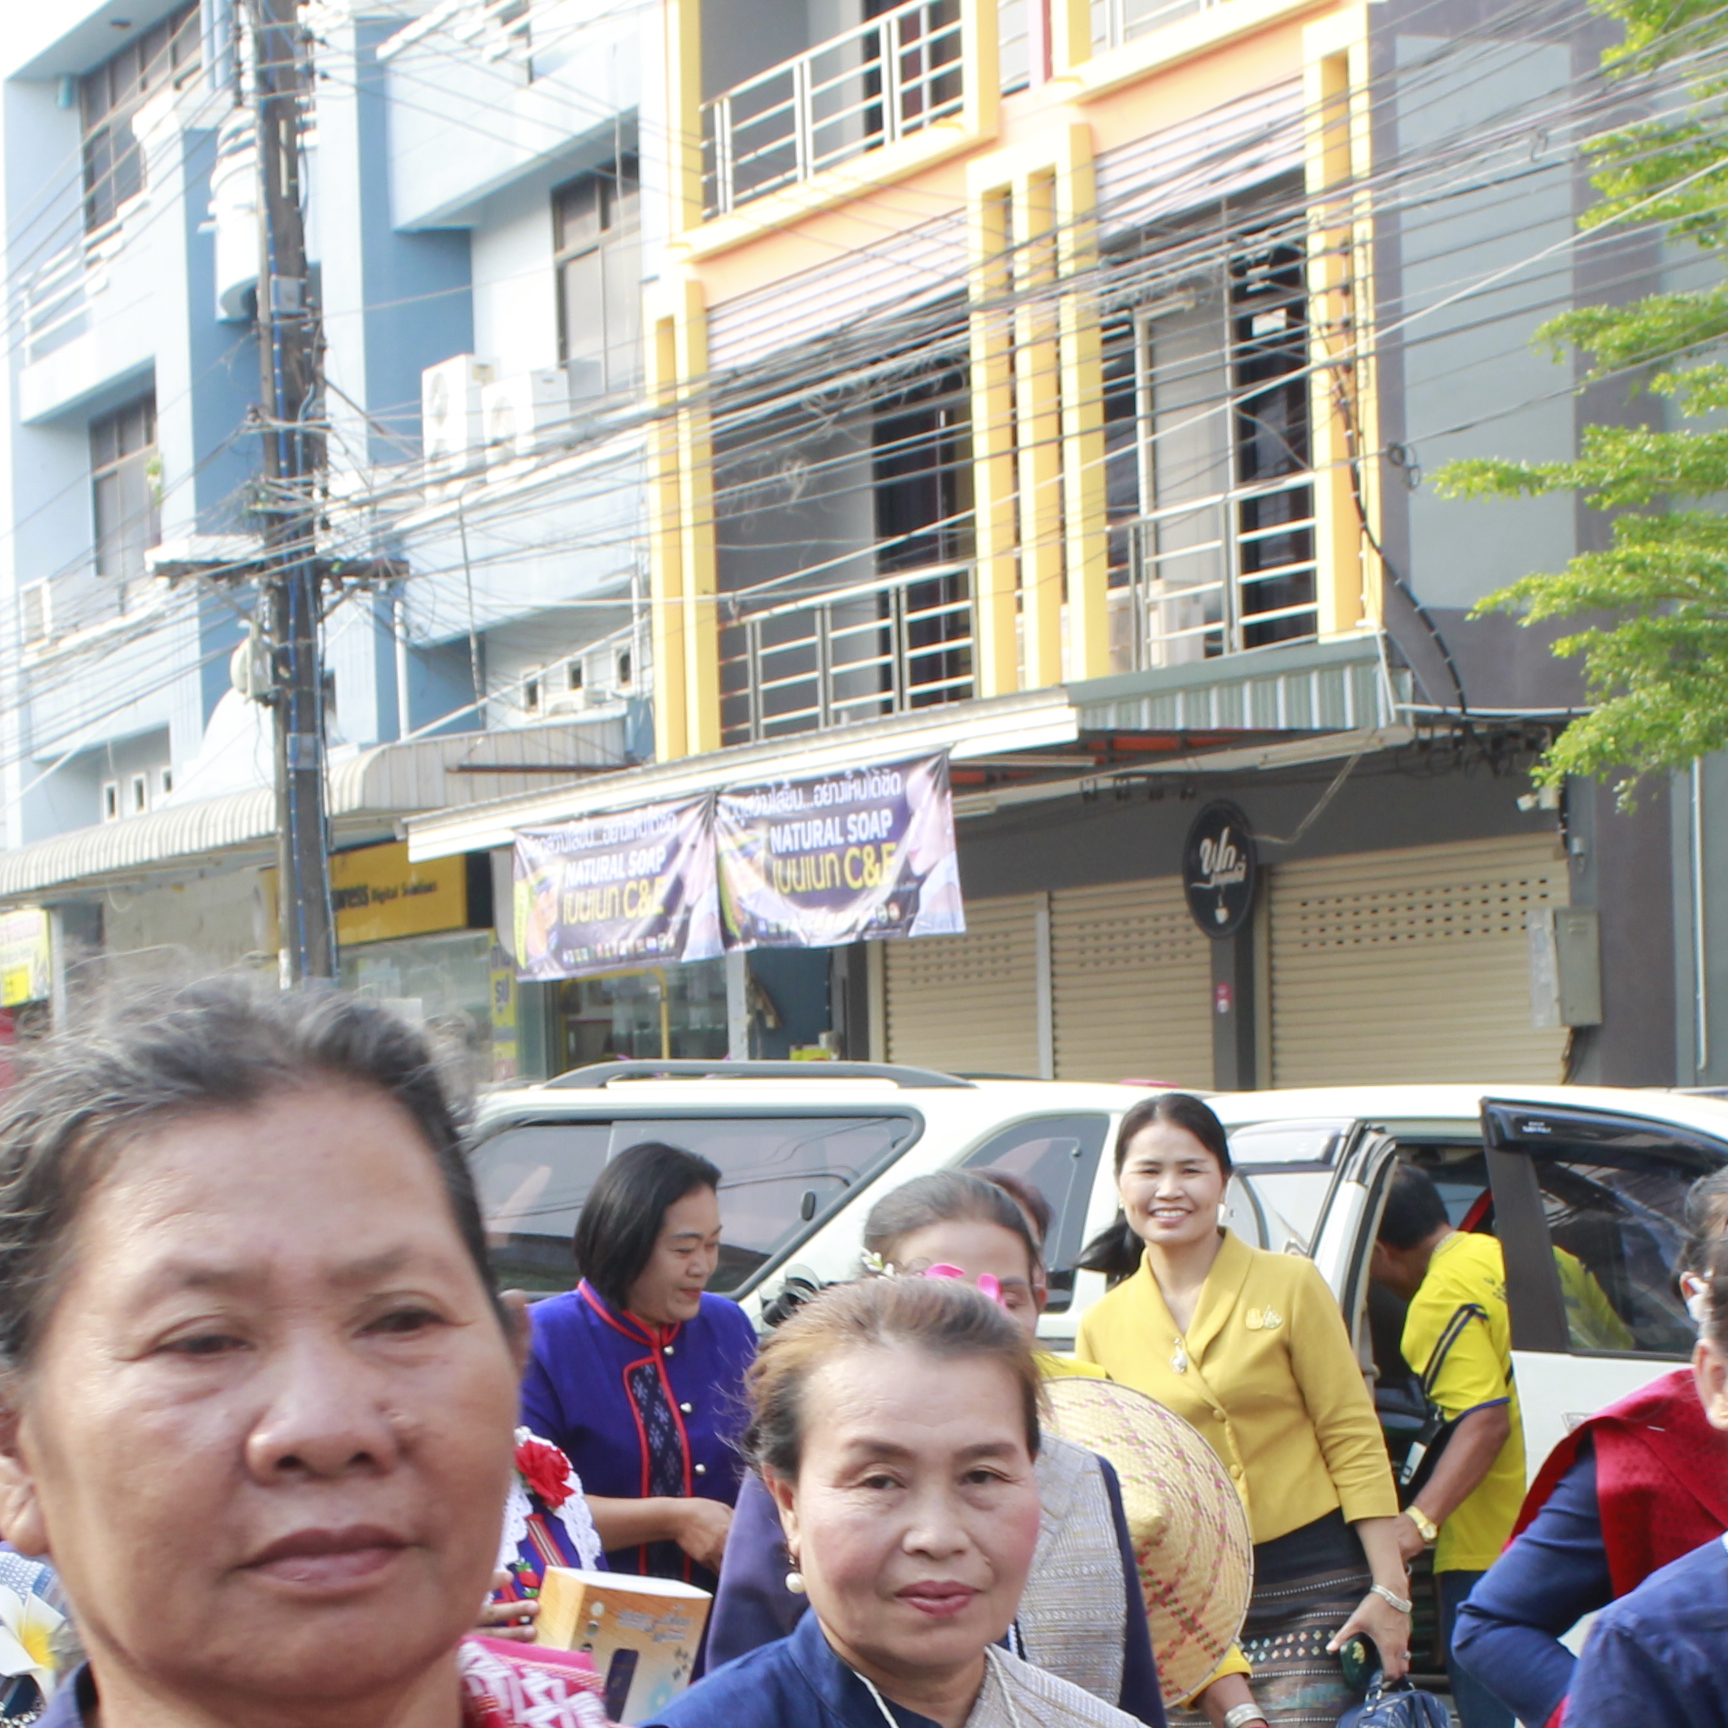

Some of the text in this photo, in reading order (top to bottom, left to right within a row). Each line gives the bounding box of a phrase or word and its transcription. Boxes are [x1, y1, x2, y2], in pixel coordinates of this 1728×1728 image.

[771, 808, 893, 855] NATURAL SOAP
[565, 845, 667, 888] NATURAL SOAP
[843, 841, 897, 890] C&E
